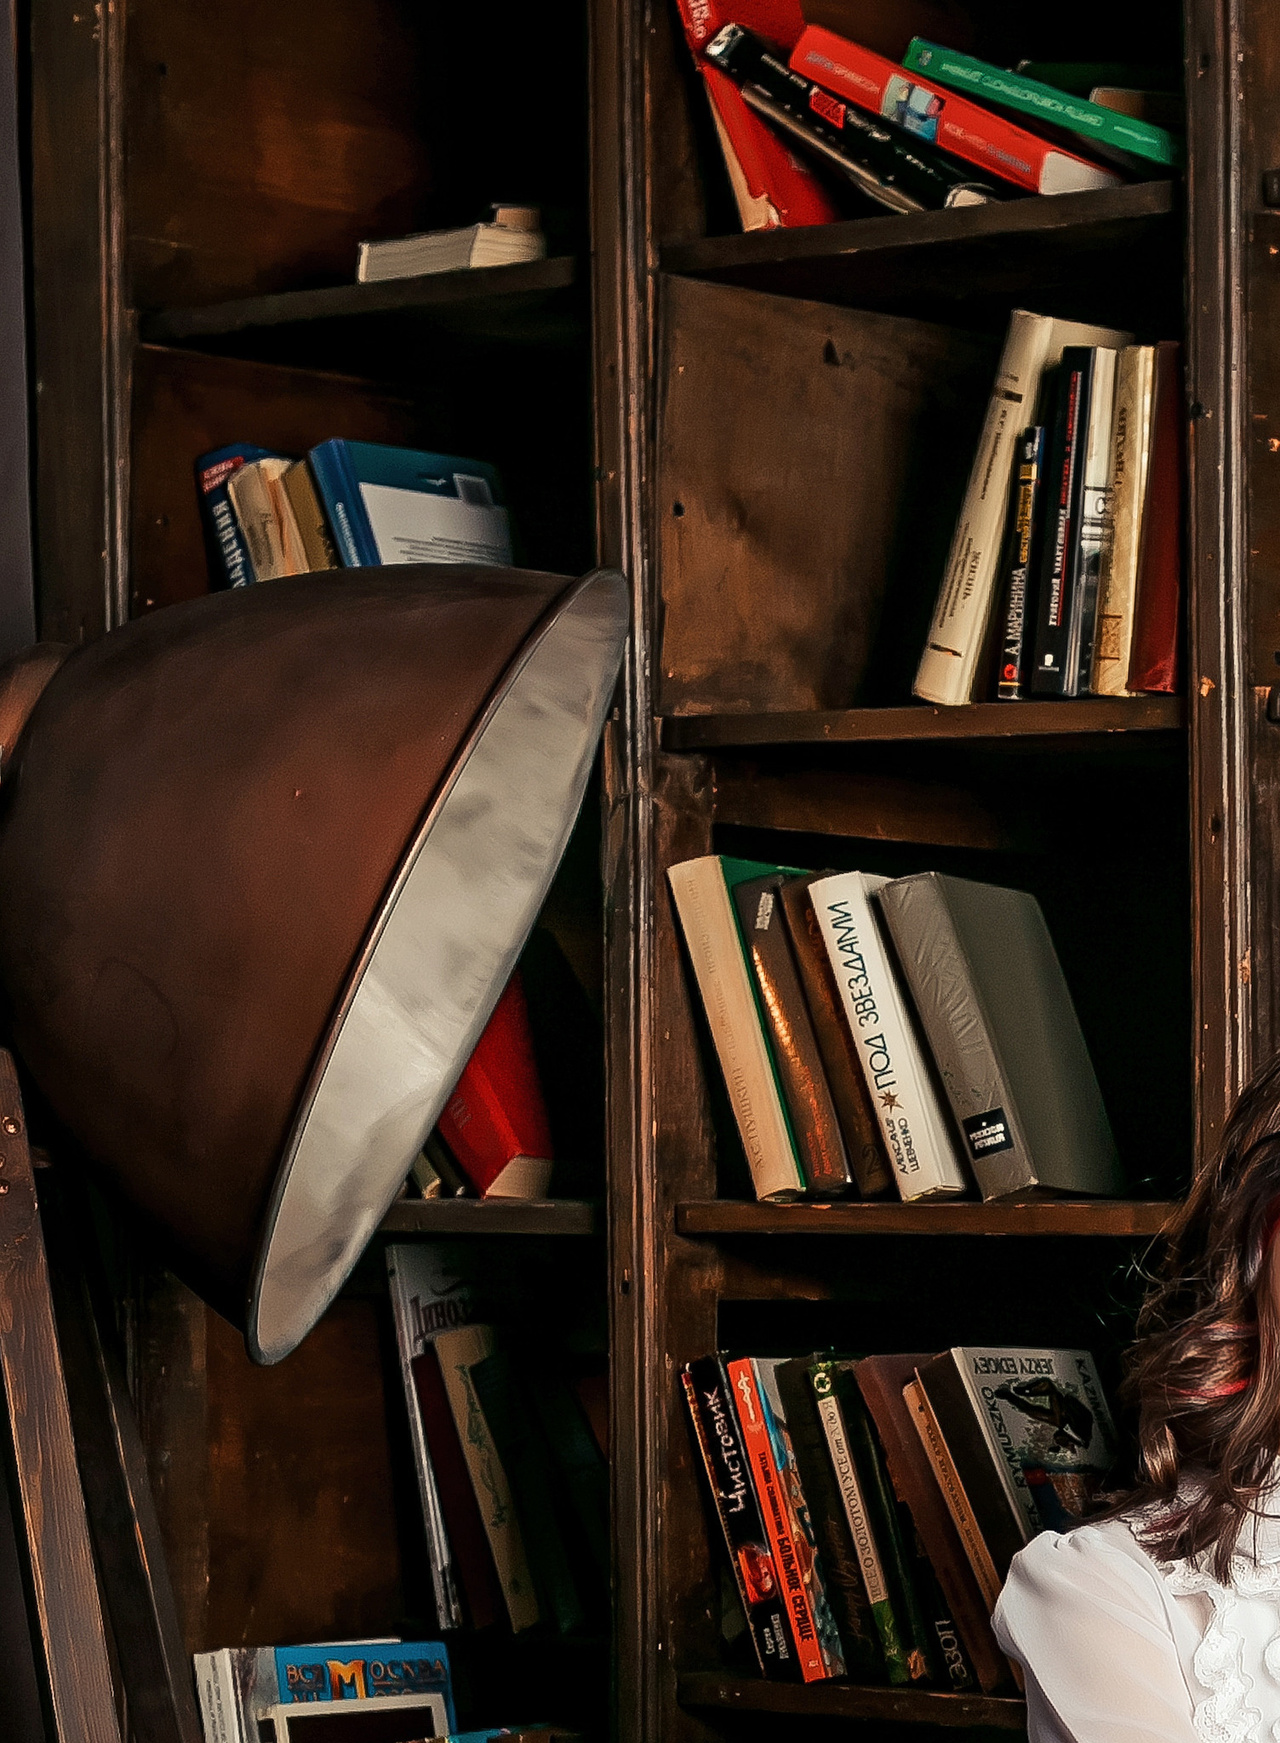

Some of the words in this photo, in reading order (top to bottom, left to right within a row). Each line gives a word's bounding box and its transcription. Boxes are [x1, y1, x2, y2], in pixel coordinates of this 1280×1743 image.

[1006, 568, 1026, 641] МАРИНИНА
[828, 901, 879, 1027] ЗВЕЗДАМИ
[863, 1033, 896, 1091] ПОД
[1015, 1357, 1052, 1378] JERZY
[703, 1385, 749, 1515] Чистовик
[836, 1456, 853, 1484] УСЕ
[979, 1386, 1032, 1489] RYMUSZKO
[838, 1483, 876, 1556] ЗОЛОТОМ
[777, 1536, 802, 1592] БОЛЬНОЕ
[791, 1594, 817, 1641] СЕРДЦЕ
